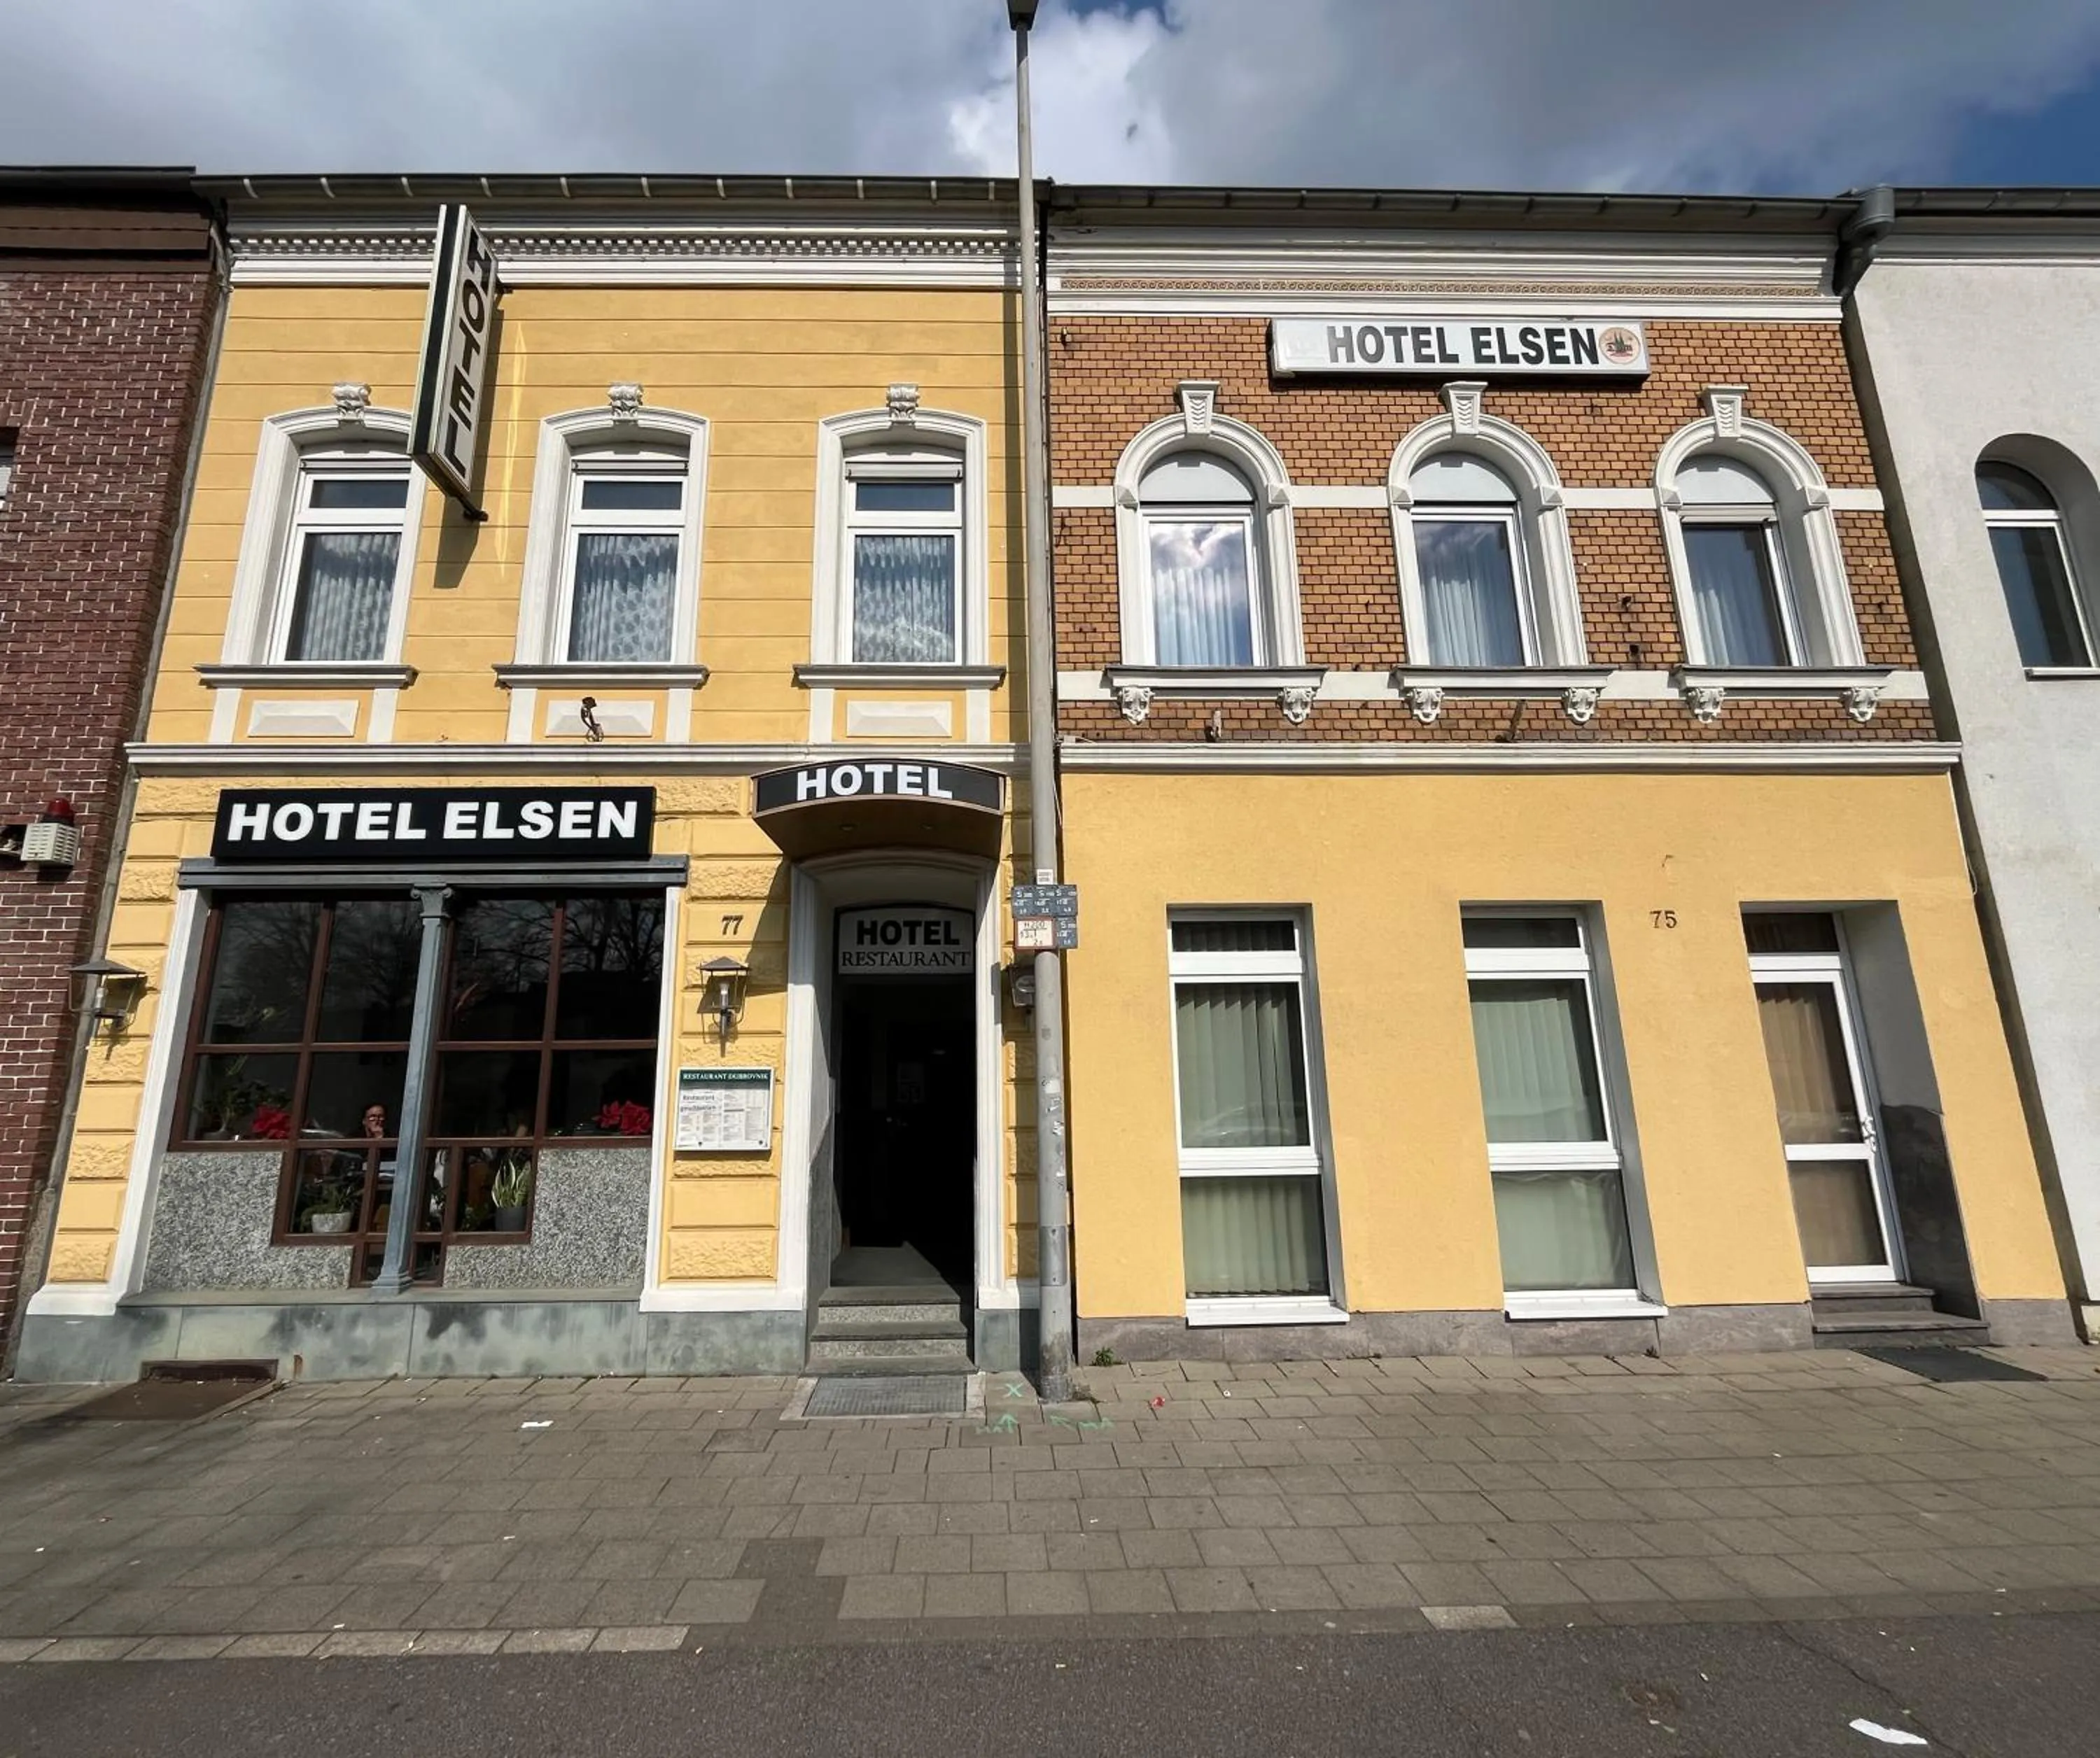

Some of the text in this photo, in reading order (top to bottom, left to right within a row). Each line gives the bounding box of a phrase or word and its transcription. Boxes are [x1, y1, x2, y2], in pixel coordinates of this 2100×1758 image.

[444, 224, 491, 480] HOTEL
[1326, 325, 1600, 365] HOTEL ELSEN
[797, 764, 953, 801] HOTEL
[226, 801, 638, 841] HOTEL ELSEN
[722, 915, 743, 935] 77
[856, 920, 960, 945] HOTEL
[1649, 910, 1677, 929] 75
[841, 951, 972, 966] RESTAURANT
